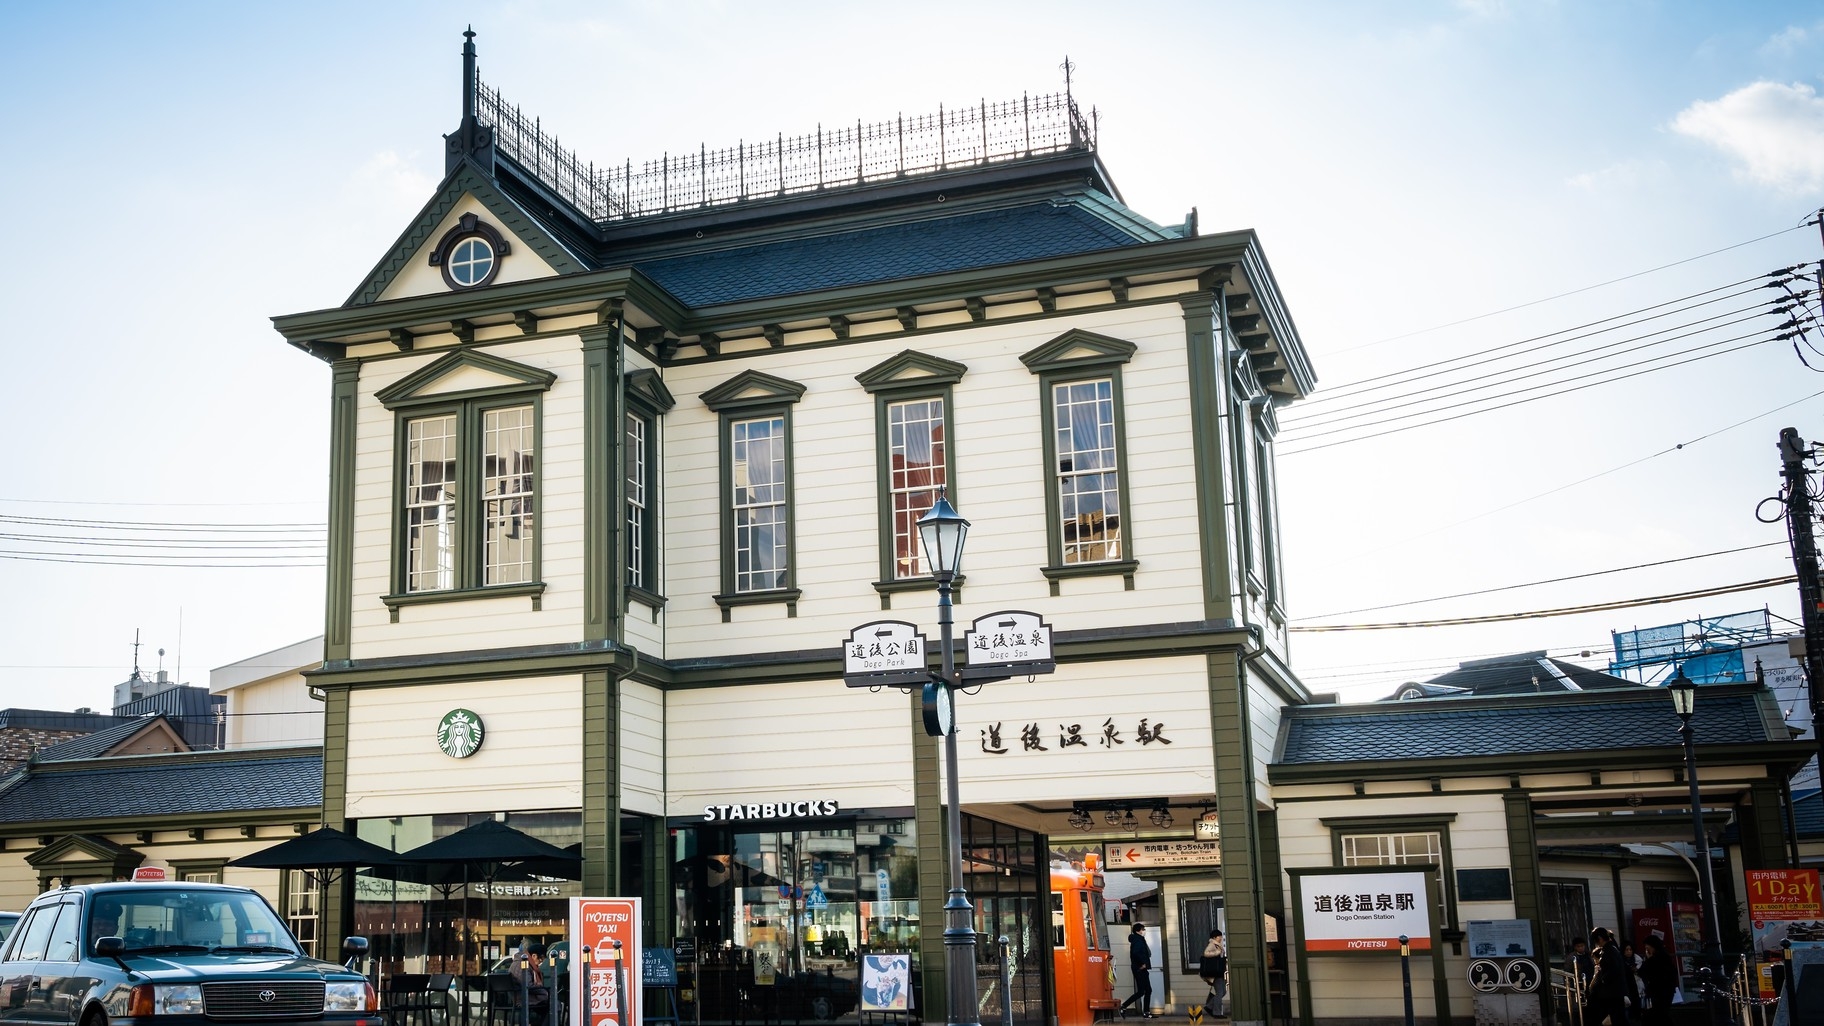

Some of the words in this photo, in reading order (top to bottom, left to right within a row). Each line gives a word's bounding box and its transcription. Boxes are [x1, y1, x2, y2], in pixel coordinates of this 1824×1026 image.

[973, 629, 1045, 650] 道後温泉
[850, 639, 919, 659] 道後公園
[990, 651, 1009, 659] Dogo
[1014, 649, 1028, 658] Spa
[864, 660, 882, 668] Dogo
[886, 658, 905, 667] Park
[979, 716, 1173, 755] 道後温泉駅
[704, 800, 838, 821] STARBUCKS
[1752, 871, 1787, 880] 市内電車
[1314, 893, 1415, 913] 道後温泉駅
[1771, 895, 1800, 903] チケット
[586, 912, 628, 922] IYOTETSU
[597, 924, 617, 933] TAXI
[1347, 940, 1388, 948] IYOTETSU
[590, 973, 616, 985] 伊予
[591, 998, 618, 1010] のり
